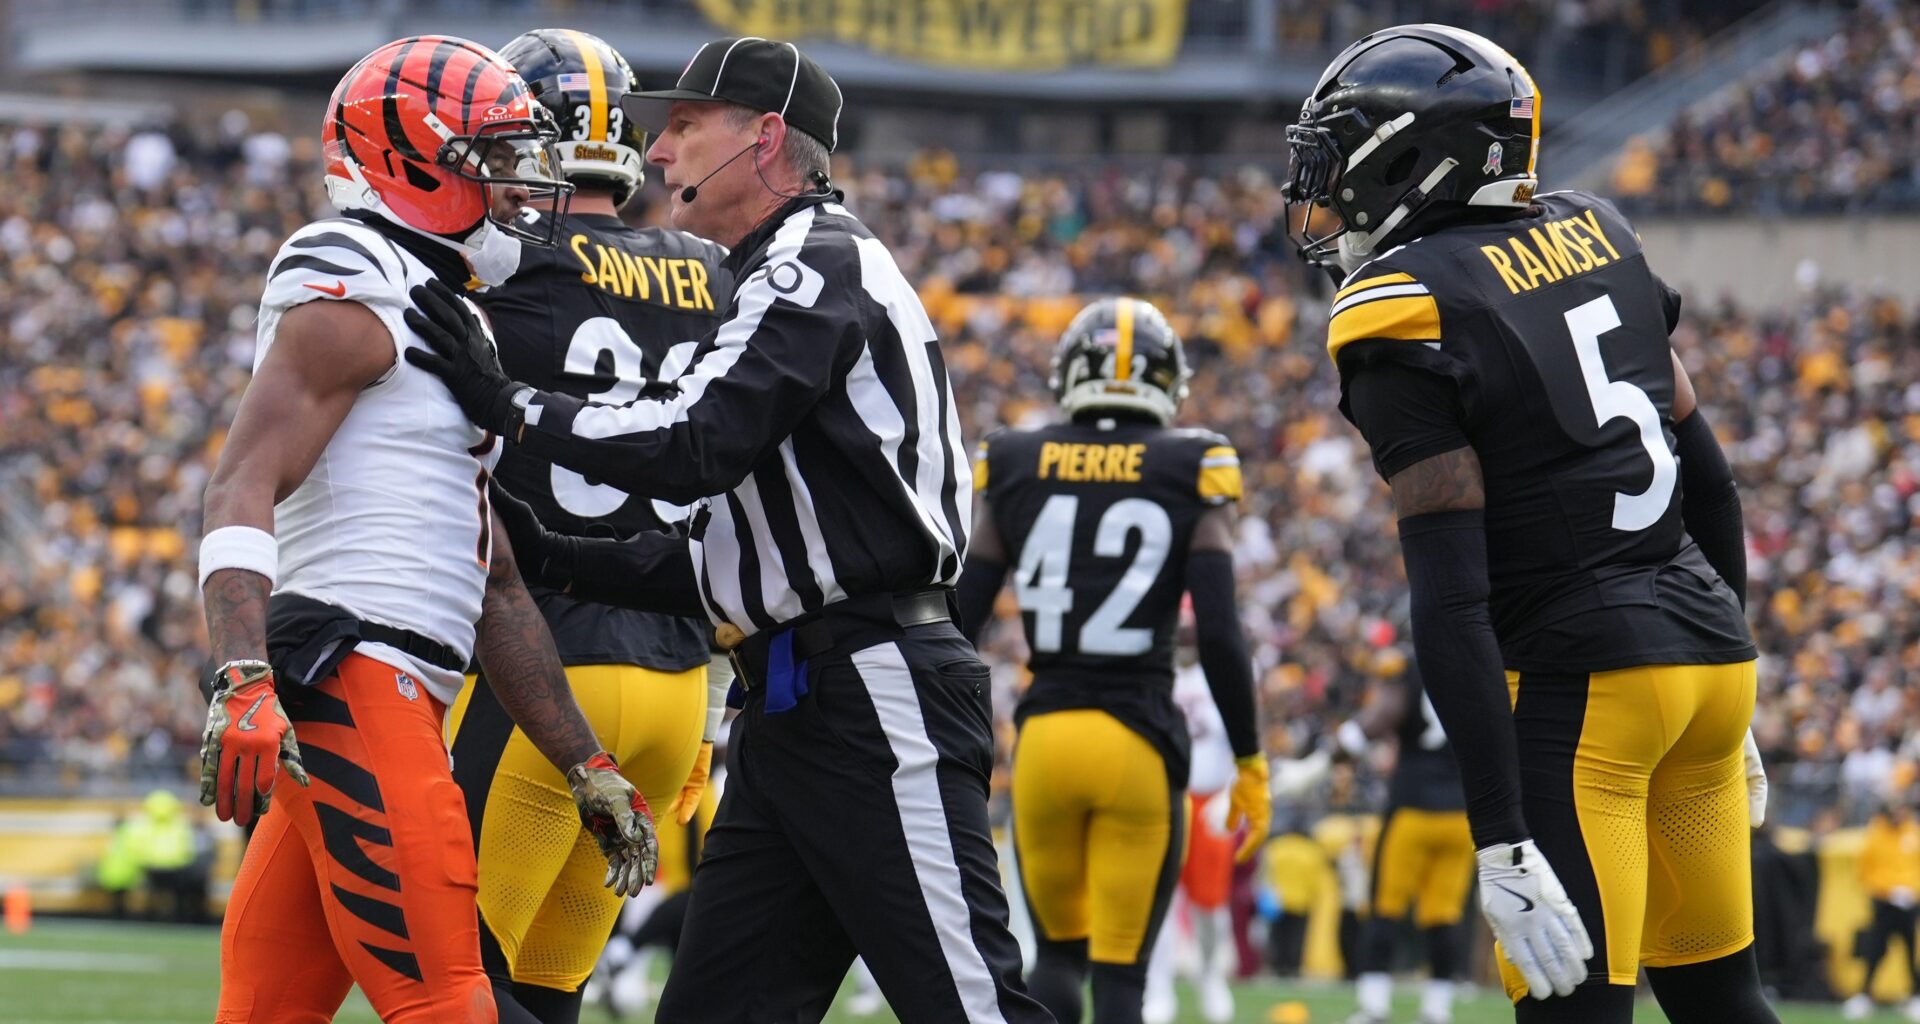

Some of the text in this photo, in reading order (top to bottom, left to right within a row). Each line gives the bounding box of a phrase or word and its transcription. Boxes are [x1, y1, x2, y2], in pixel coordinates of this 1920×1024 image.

[574, 144, 617, 162] Steelers
[571, 234, 714, 311] SAWYER
[1480, 209, 1621, 294] RAMSEY
[1564, 294, 1677, 532] 5
[1038, 442, 1147, 482] PIERRE
[1015, 495, 1173, 656] 42
